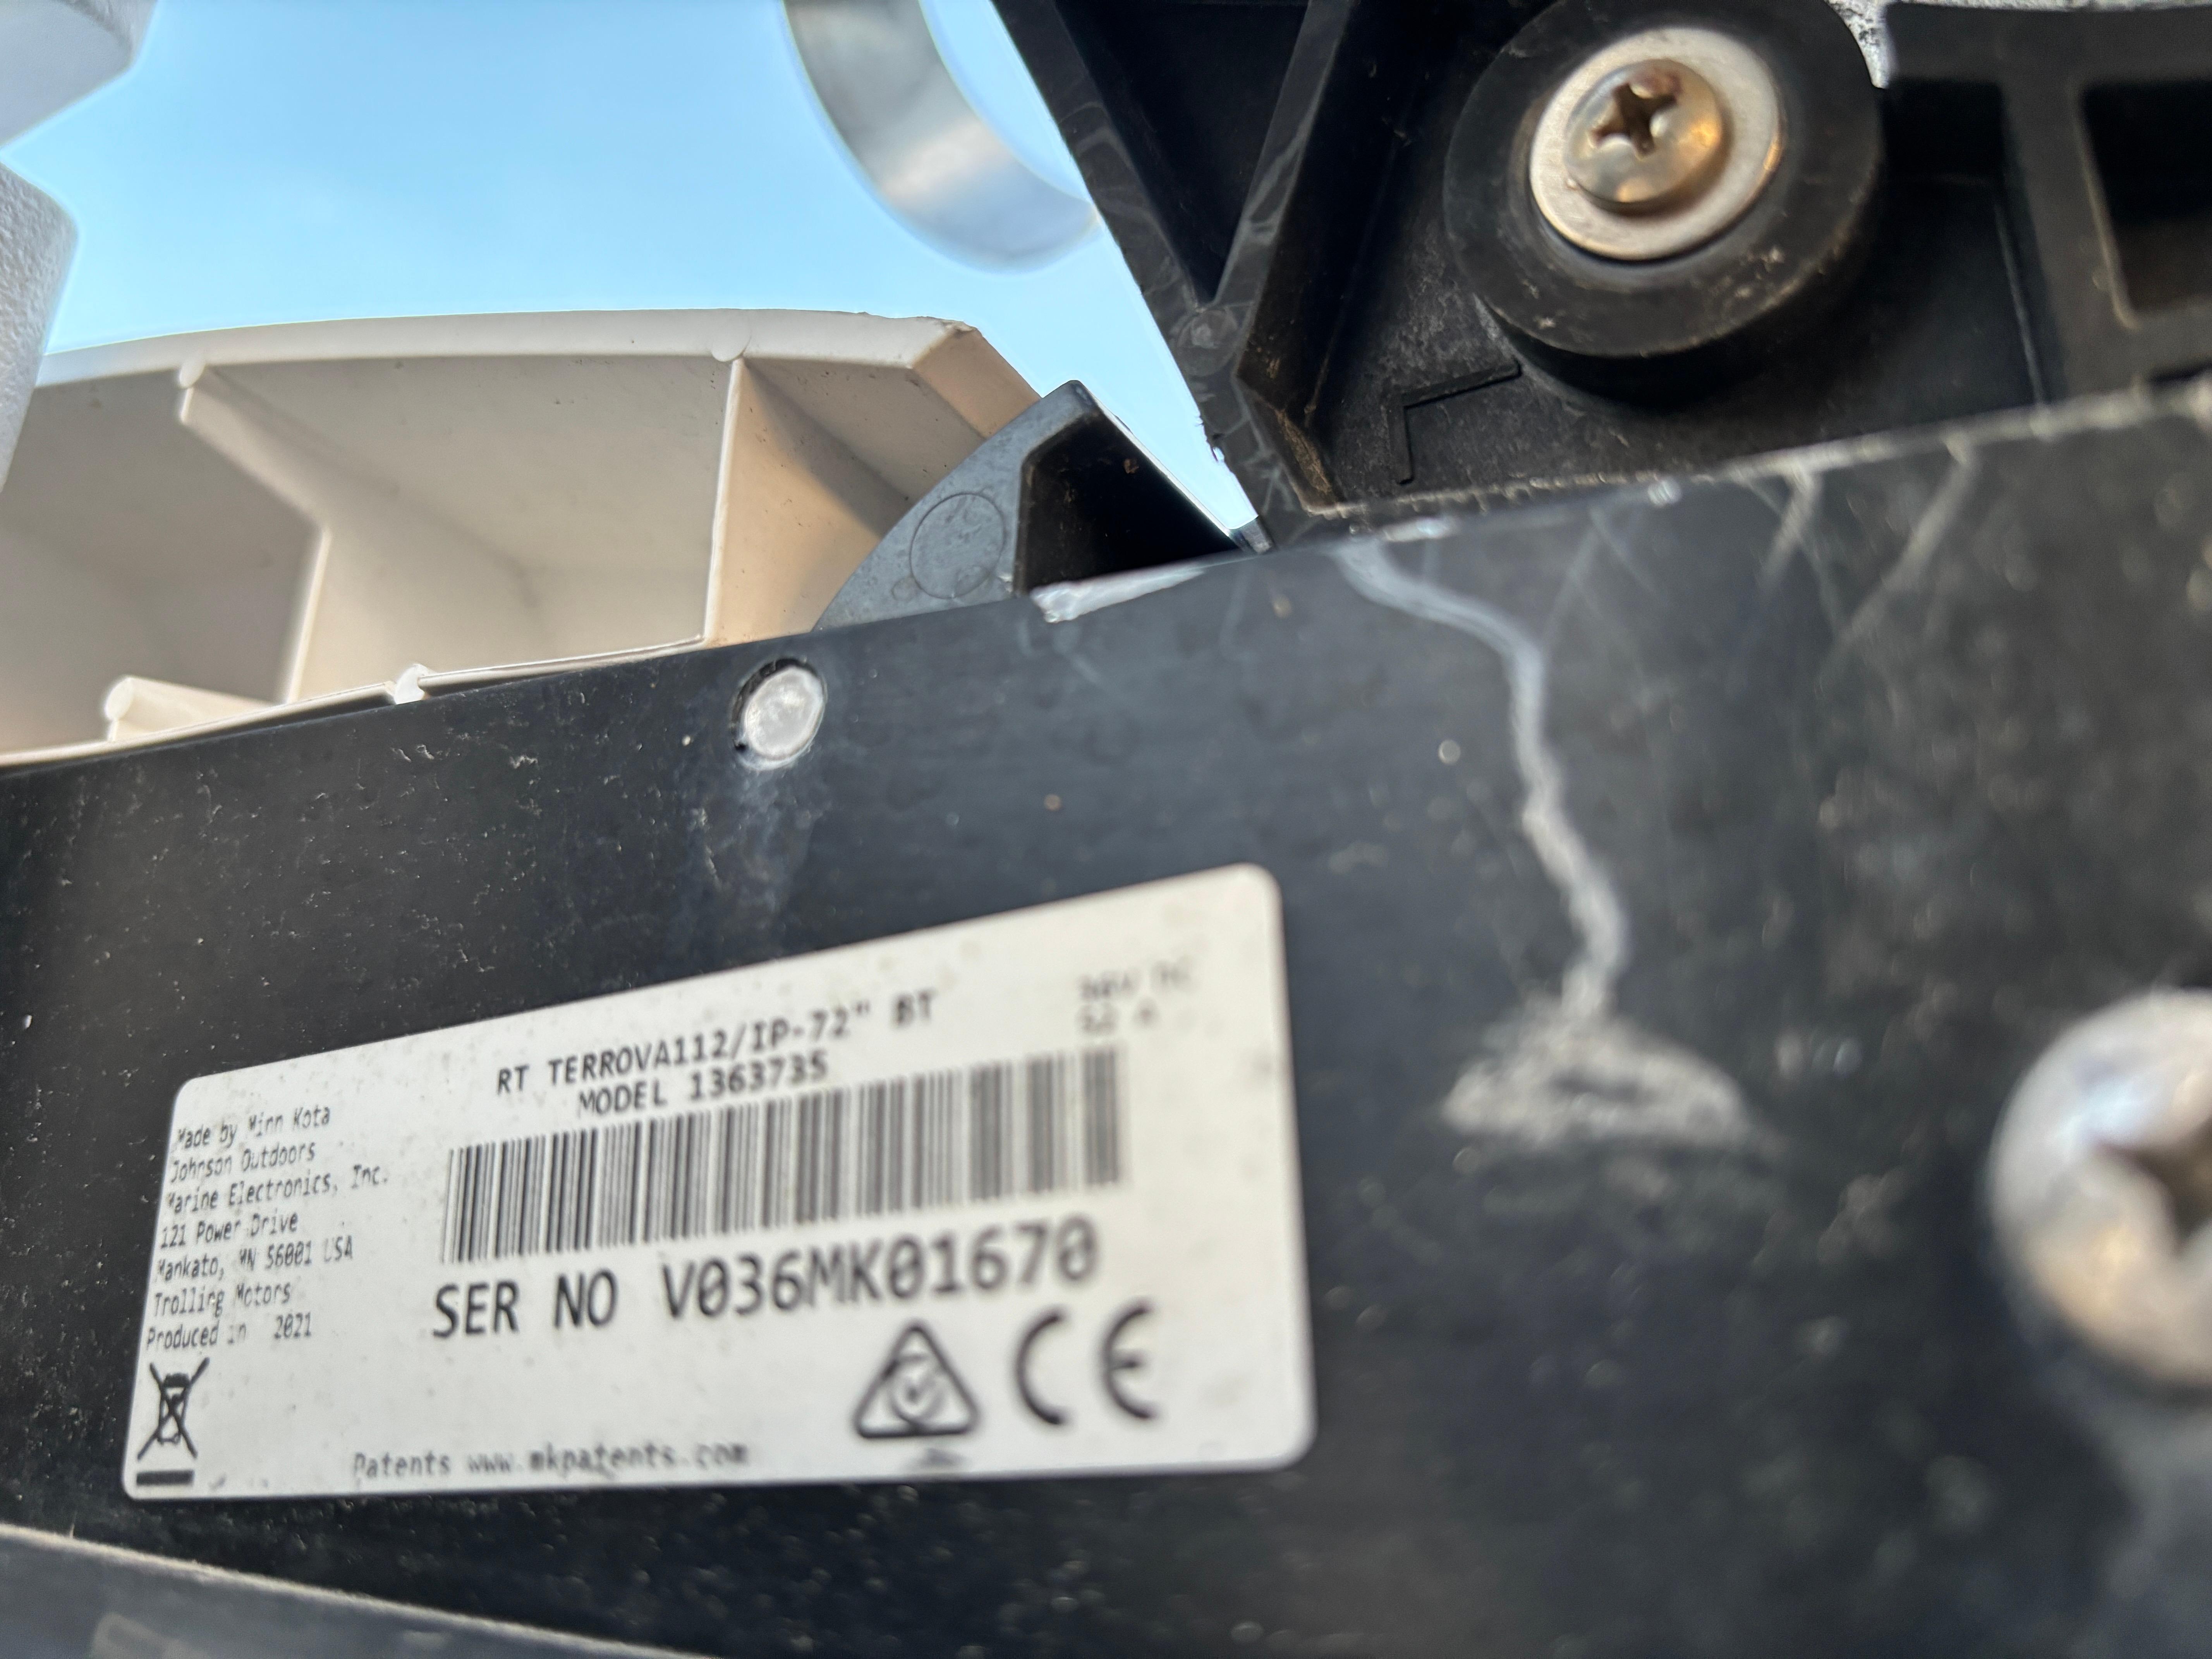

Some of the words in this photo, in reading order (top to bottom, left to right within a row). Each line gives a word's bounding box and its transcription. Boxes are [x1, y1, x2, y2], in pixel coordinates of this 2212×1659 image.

[496, 1065, 529, 1096] RT
[891, 988, 936, 1029] BT
[577, 1078, 668, 1118] MODEL
[689, 1048, 829, 1103] 1363735
[176, 1123, 213, 1150] Made
[219, 1119, 237, 1150] by
[248, 1111, 284, 1137] Minn
[293, 1105, 331, 1128] Kota
[170, 1154, 232, 1183] Johnson
[242, 1141, 316, 1173] Outdoors
[167, 1186, 220, 1215] Marine
[228, 1172, 338, 1207] Electronics,
[350, 1164, 388, 1189] Inc.
[160, 1223, 187, 1249] 121
[196, 1219, 241, 1245] Power
[251, 1209, 299, 1235] Drive
[156, 1253, 225, 1283] Mankato,
[238, 1247, 257, 1272] MN
[265, 1240, 313, 1270] 56001
[324, 1234, 353, 1263] USA
[431, 1280, 521, 1341] SER
[551, 1267, 620, 1332] NO
[659, 1212, 1101, 1322] V036MK01670
[153, 1286, 225, 1317] Trolling
[235, 1281, 292, 1308] Motors
[146, 1320, 220, 1351] Produced
[227, 1322, 247, 1345] in
[273, 1311, 312, 1340] 2021
[353, 1450, 451, 1479] Patents
